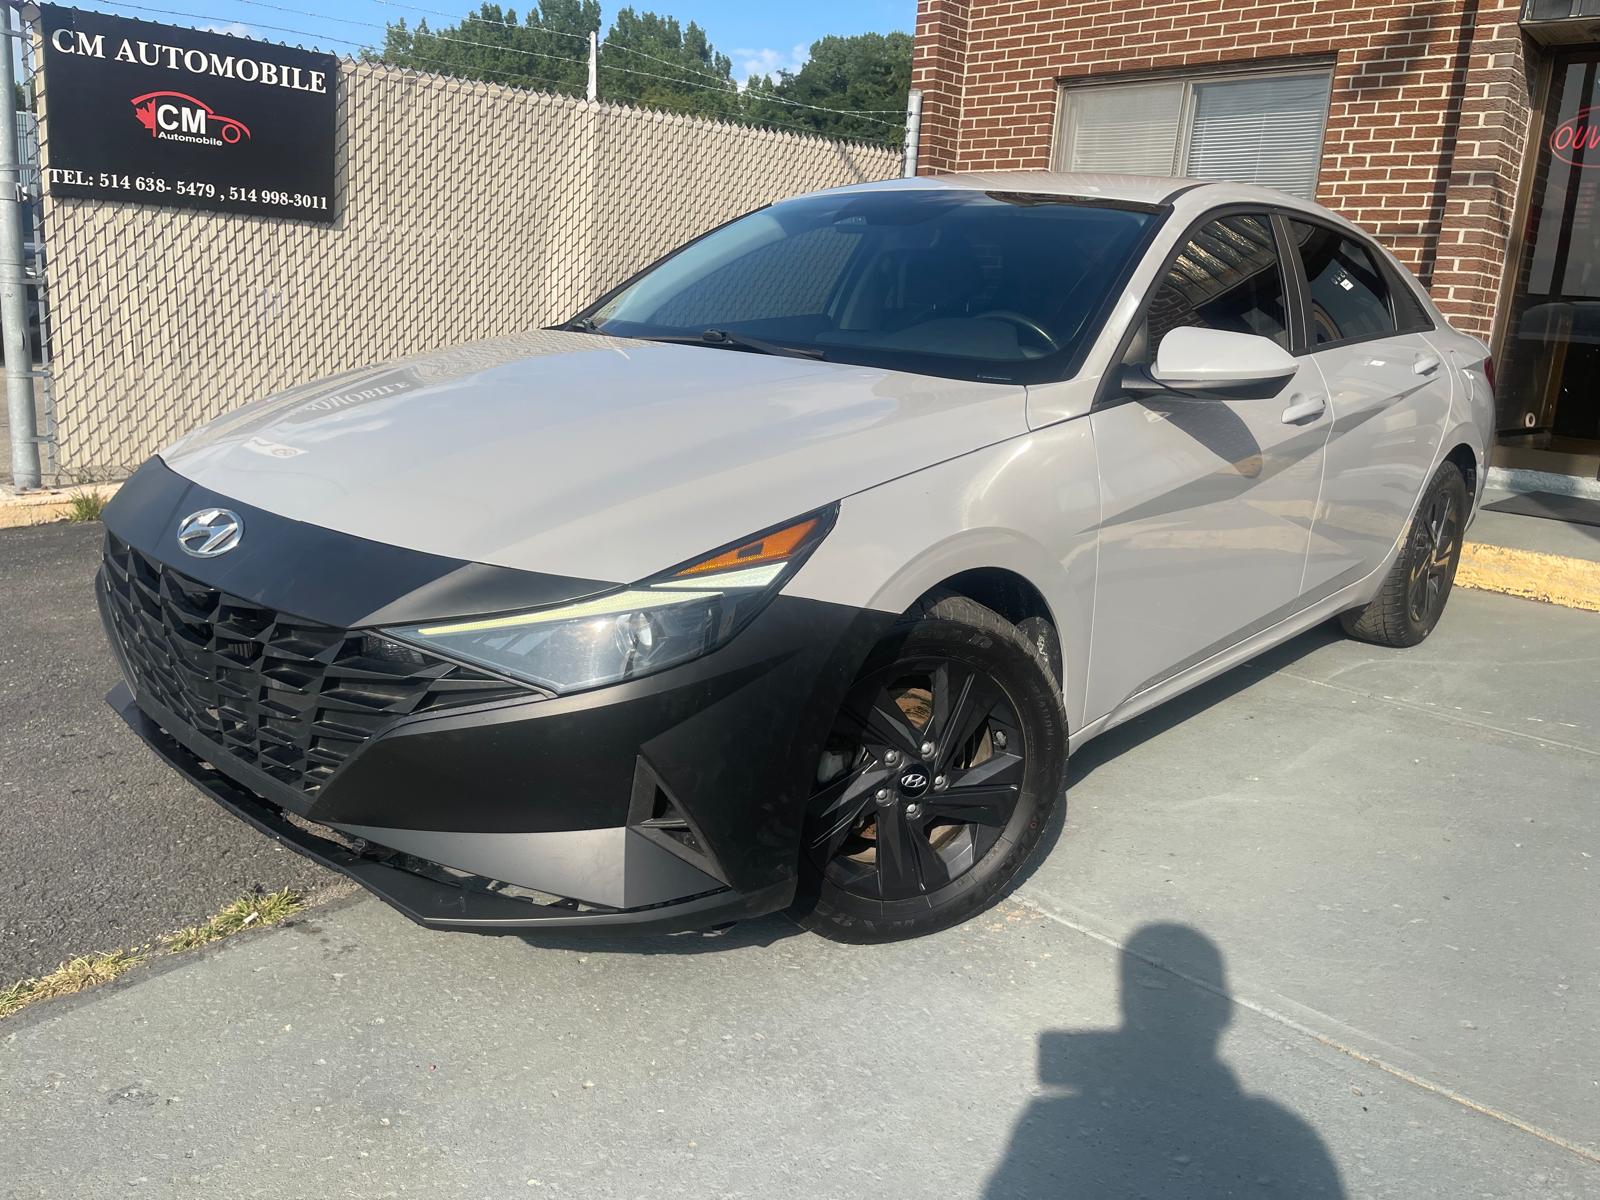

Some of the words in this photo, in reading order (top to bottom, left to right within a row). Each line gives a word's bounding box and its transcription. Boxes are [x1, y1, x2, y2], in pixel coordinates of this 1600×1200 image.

[51, 28, 106, 58] CM
[114, 38, 327, 94] AUTOMOBILE
[157, 104, 206, 134] CM
[158, 131, 223, 147] Automobile
[49, 168, 94, 186] TEL:
[99, 173, 131, 190] 514
[176, 180, 216, 198] 5479
[261, 190, 328, 210] 998-3011
